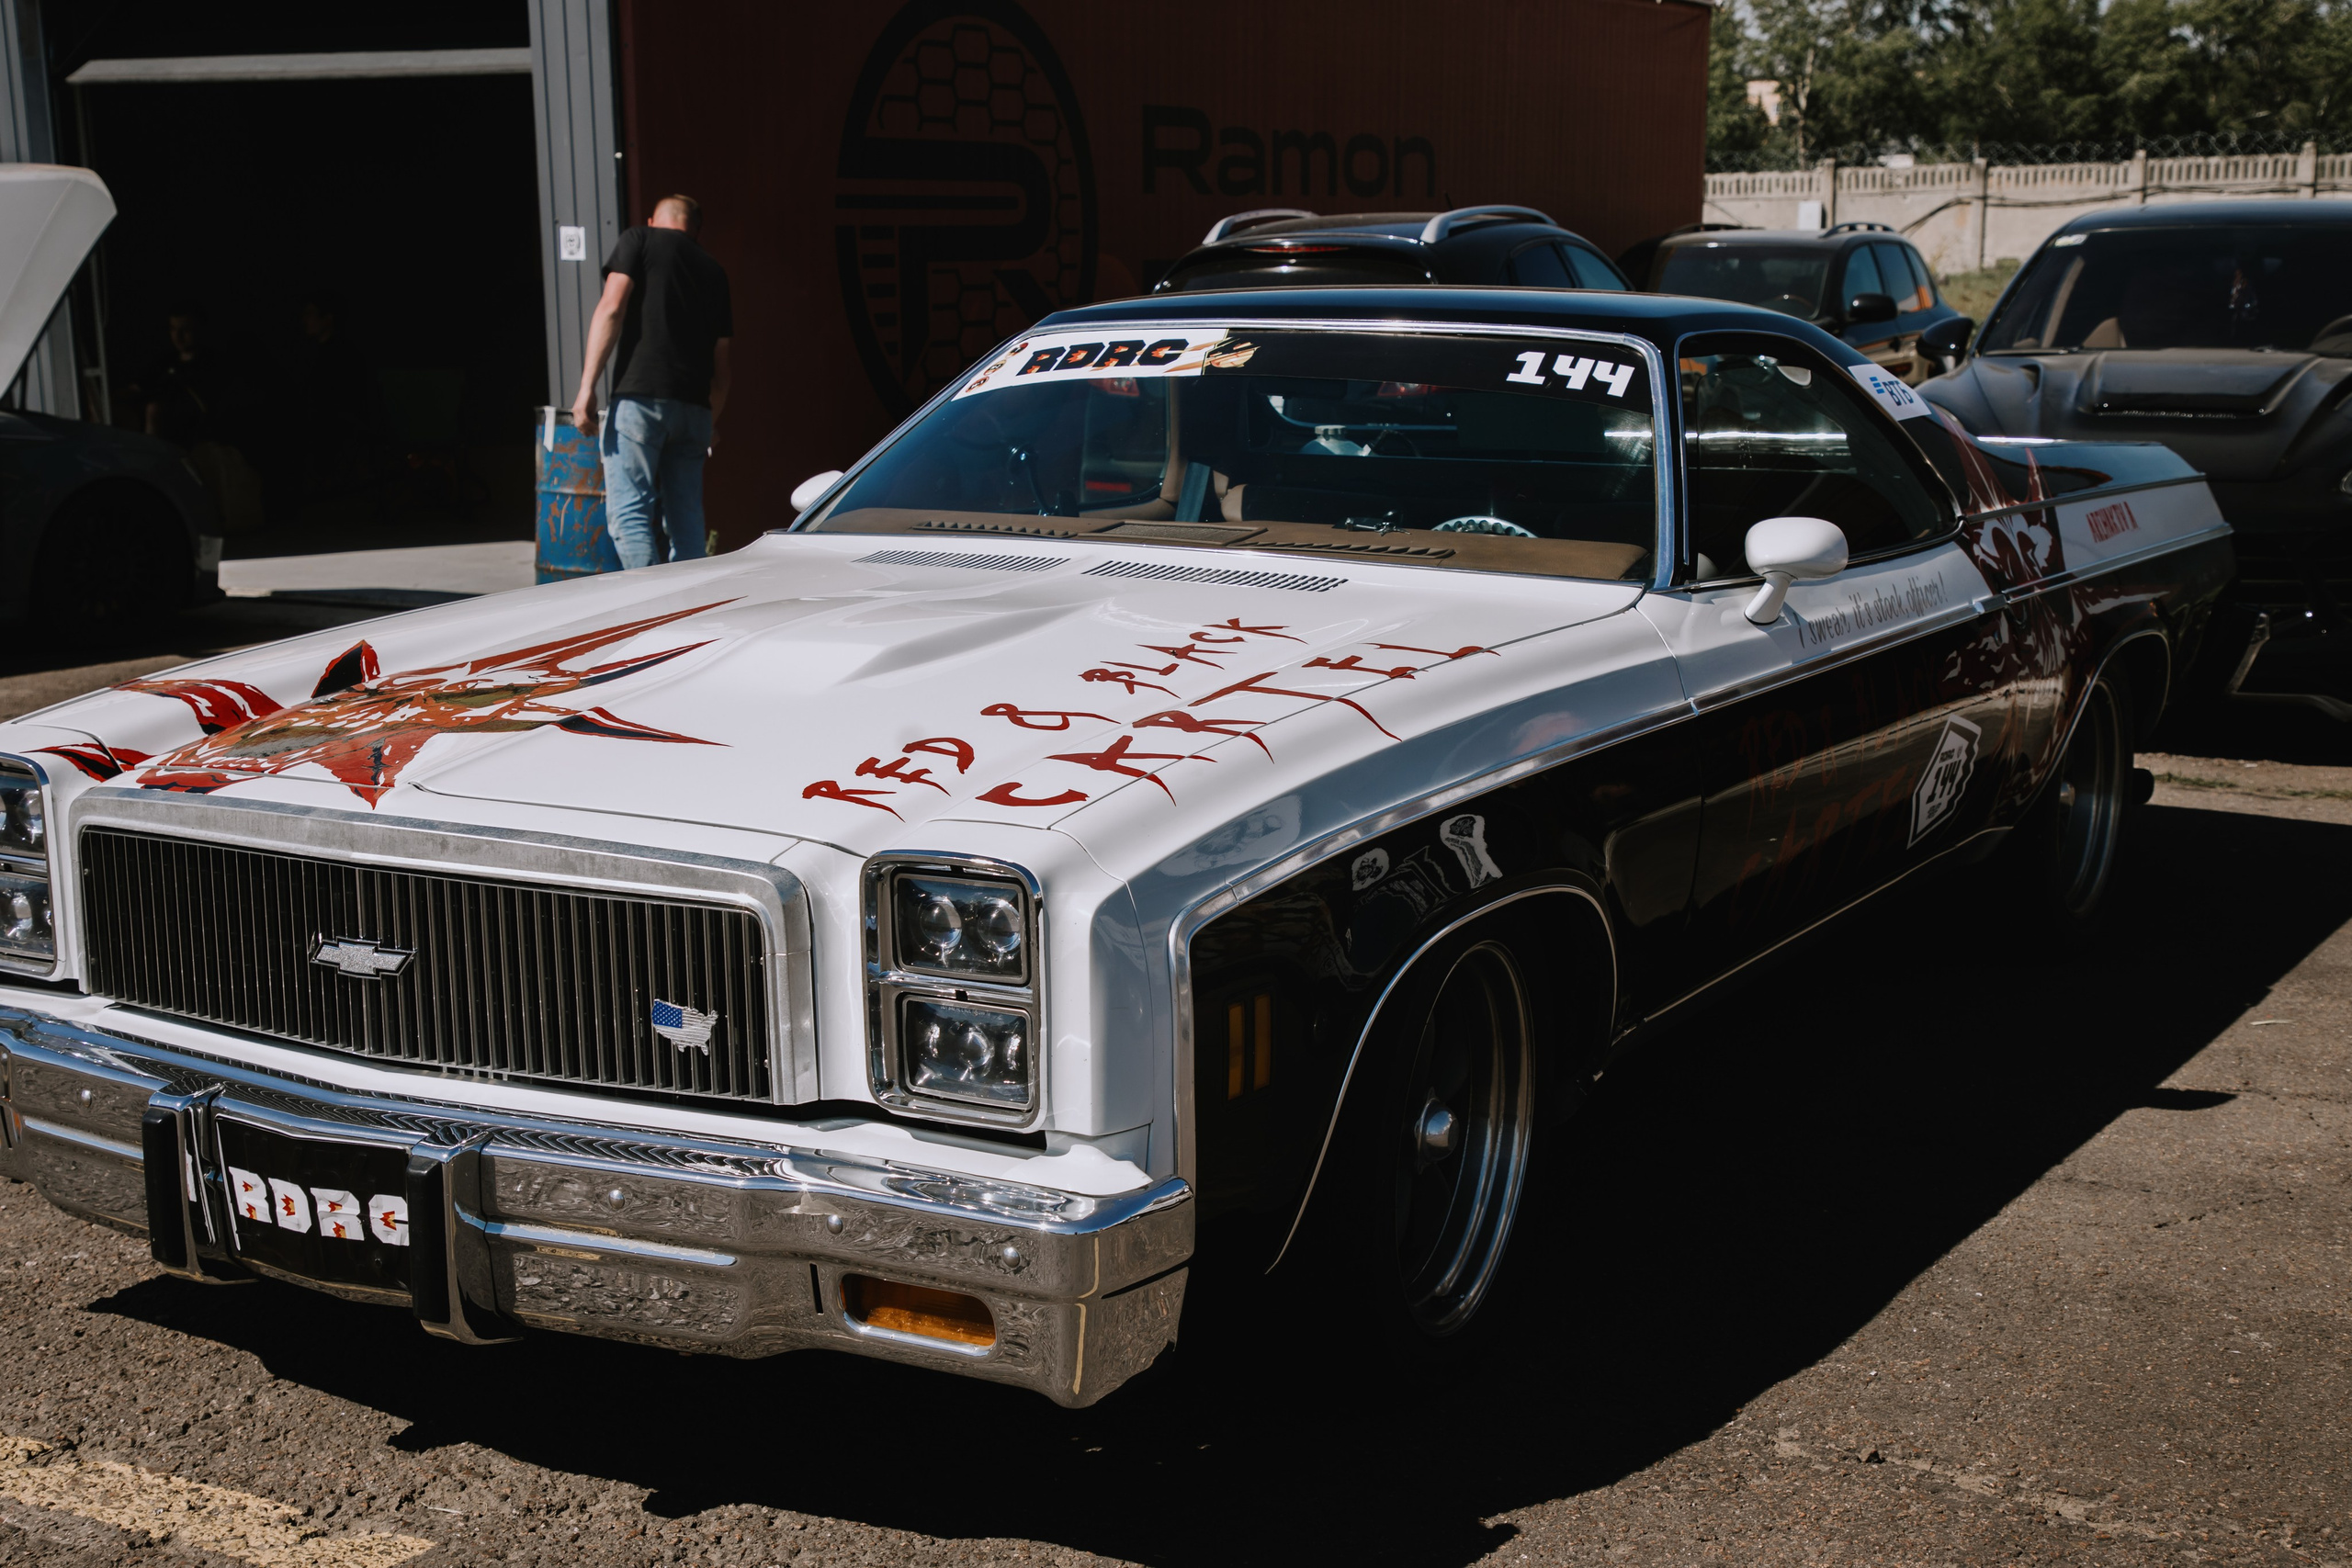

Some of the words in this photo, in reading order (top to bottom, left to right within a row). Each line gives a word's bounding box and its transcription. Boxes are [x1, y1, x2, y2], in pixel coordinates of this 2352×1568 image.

[1142, 104, 1436, 197] Ramon
[1016, 339, 1189, 376] RDRC
[1505, 351, 1635, 398] 144
[1807, 606, 1851, 645] swear
[802, 737, 975, 823] RED
[1078, 618, 1309, 700] BLACK
[975, 642, 1502, 807] CARTEL
[1926, 759, 1962, 805] 144
[228, 1165, 410, 1247] RDRC
